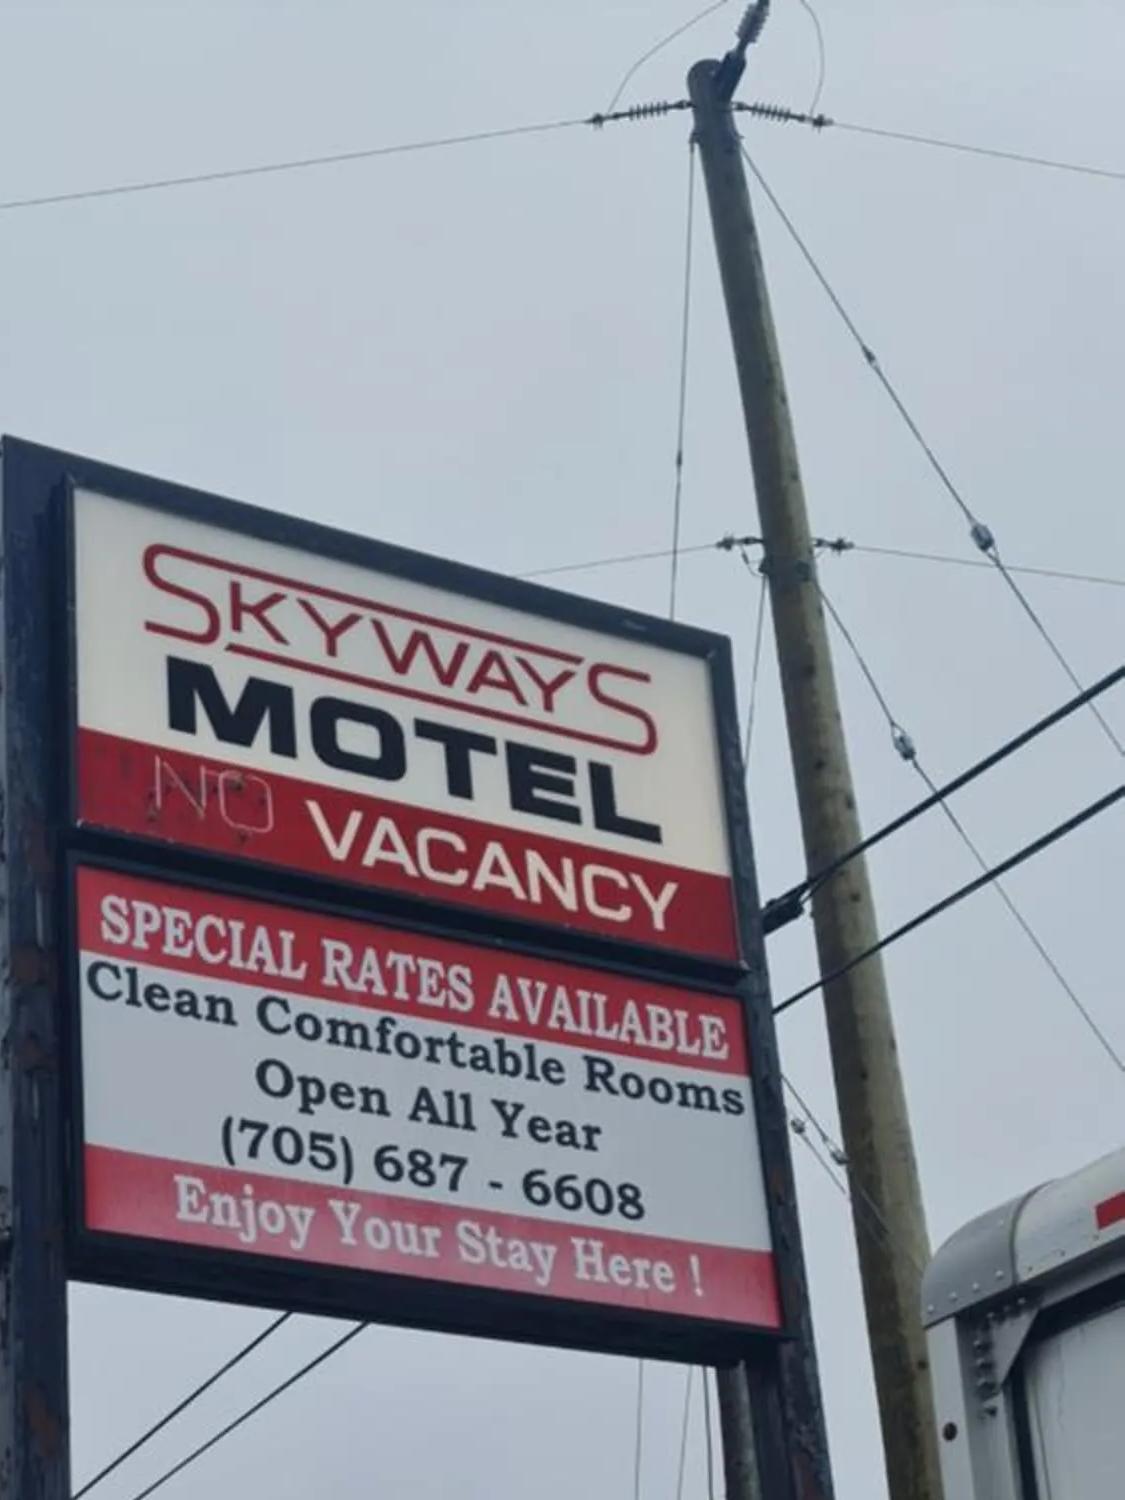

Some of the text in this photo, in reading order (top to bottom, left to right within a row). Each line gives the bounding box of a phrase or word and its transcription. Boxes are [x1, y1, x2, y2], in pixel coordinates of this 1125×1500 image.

[143, 542, 658, 756] SKYWAYS
[166, 655, 663, 844] MOTEL
[154, 755, 678, 931] NO VACANCY
[87, 961, 746, 1116] Clean Comfortable Rooms
[100, 895, 728, 1058] SPECIAL RATES AVAILABLE
[221, 1115, 354, 1185] (705)
[374, 1145, 469, 1193] 687
[522, 1169, 646, 1220] 6608
[255, 1059, 602, 1153] Open All Year
[173, 1175, 315, 1251] Enjoy
[328, 1200, 442, 1260] Your
[457, 1221, 560, 1286] Stay
[571, 1237, 675, 1293] Here
